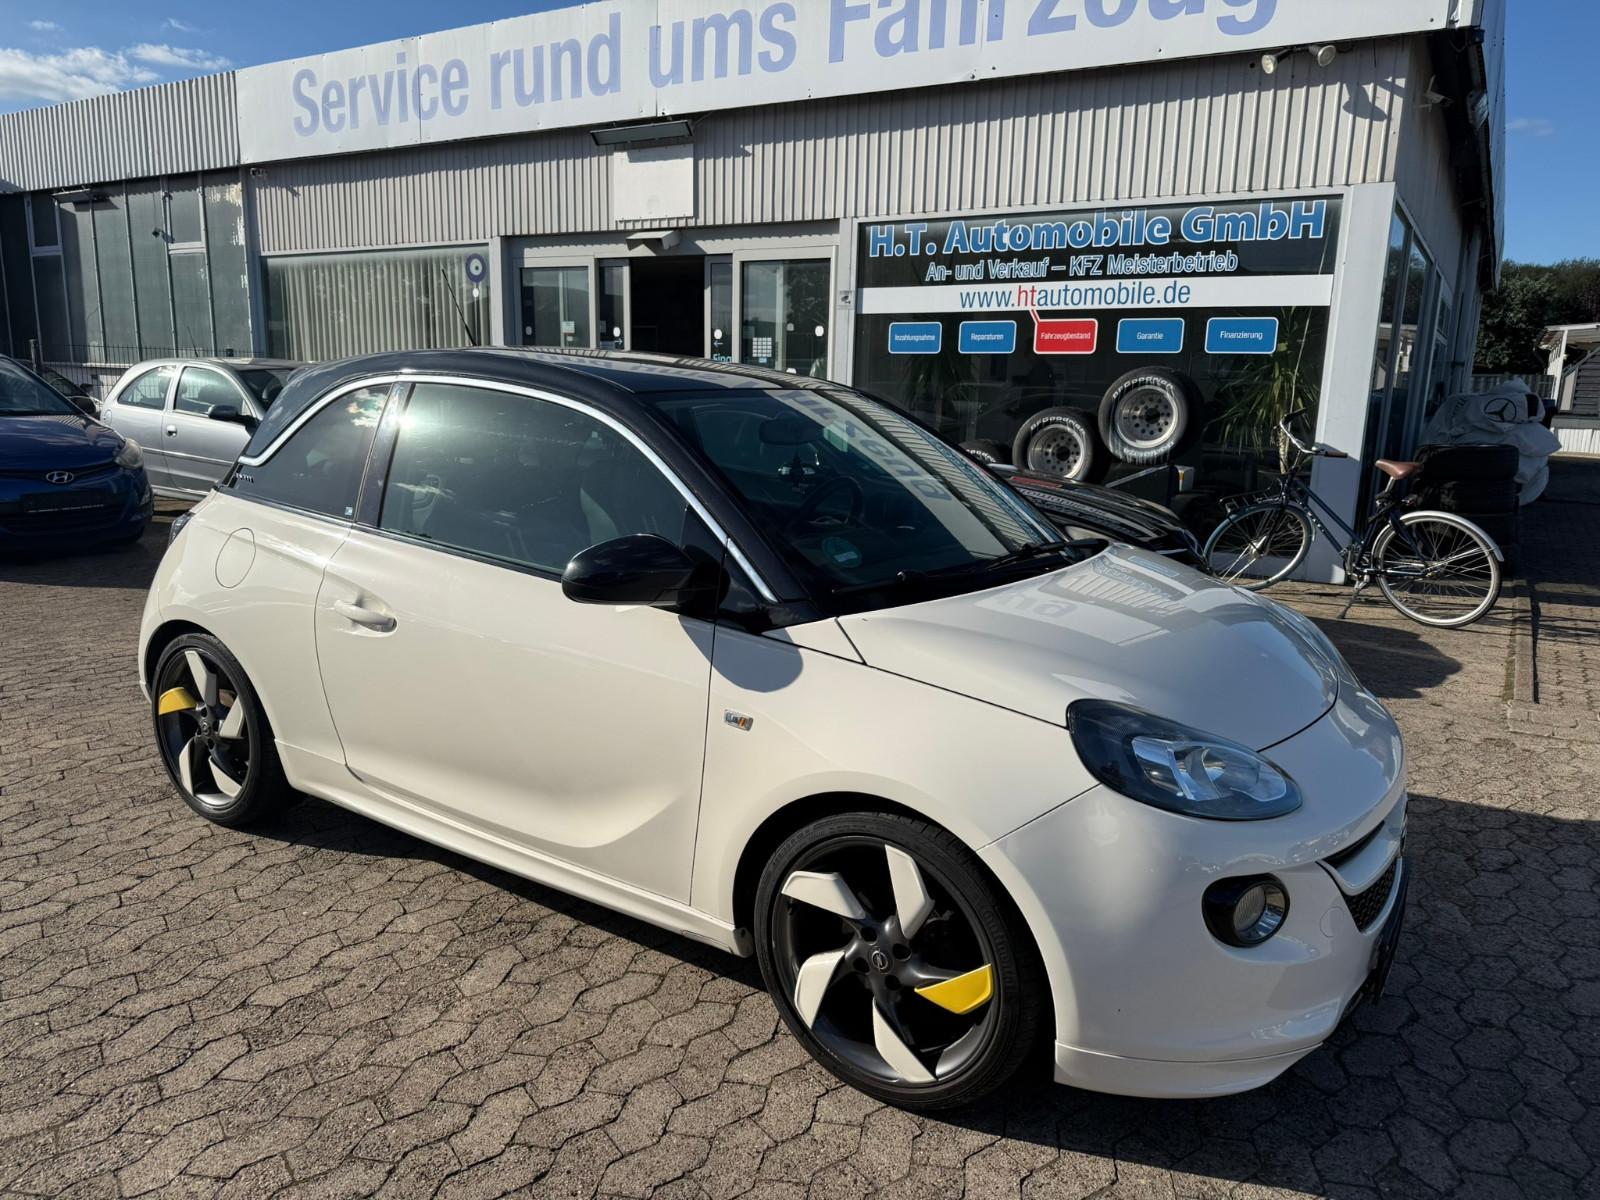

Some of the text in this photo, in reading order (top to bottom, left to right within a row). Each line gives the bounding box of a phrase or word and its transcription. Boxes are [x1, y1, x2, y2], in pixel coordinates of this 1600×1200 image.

[293, 52, 470, 137] Service
[490, 12, 622, 111] rund
[648, 2, 797, 89] ums
[869, 200, 1327, 257] H.T. Automobile GmbH
[925, 261, 952, 281] An-
[955, 259, 984, 280] und
[988, 257, 1049, 279] Verkauf
[1069, 255, 1104, 276] KFZ
[1106, 250, 1238, 275] Meisterbetrieb
[960, 280, 1191, 308] www.htautomobile.de
[970, 332, 1004, 342] Reparaturen
[1040, 331, 1091, 341] Fahrzeugbestand
[1136, 331, 1164, 340] Garantie
[1219, 330, 1263, 341] Finanzierung
